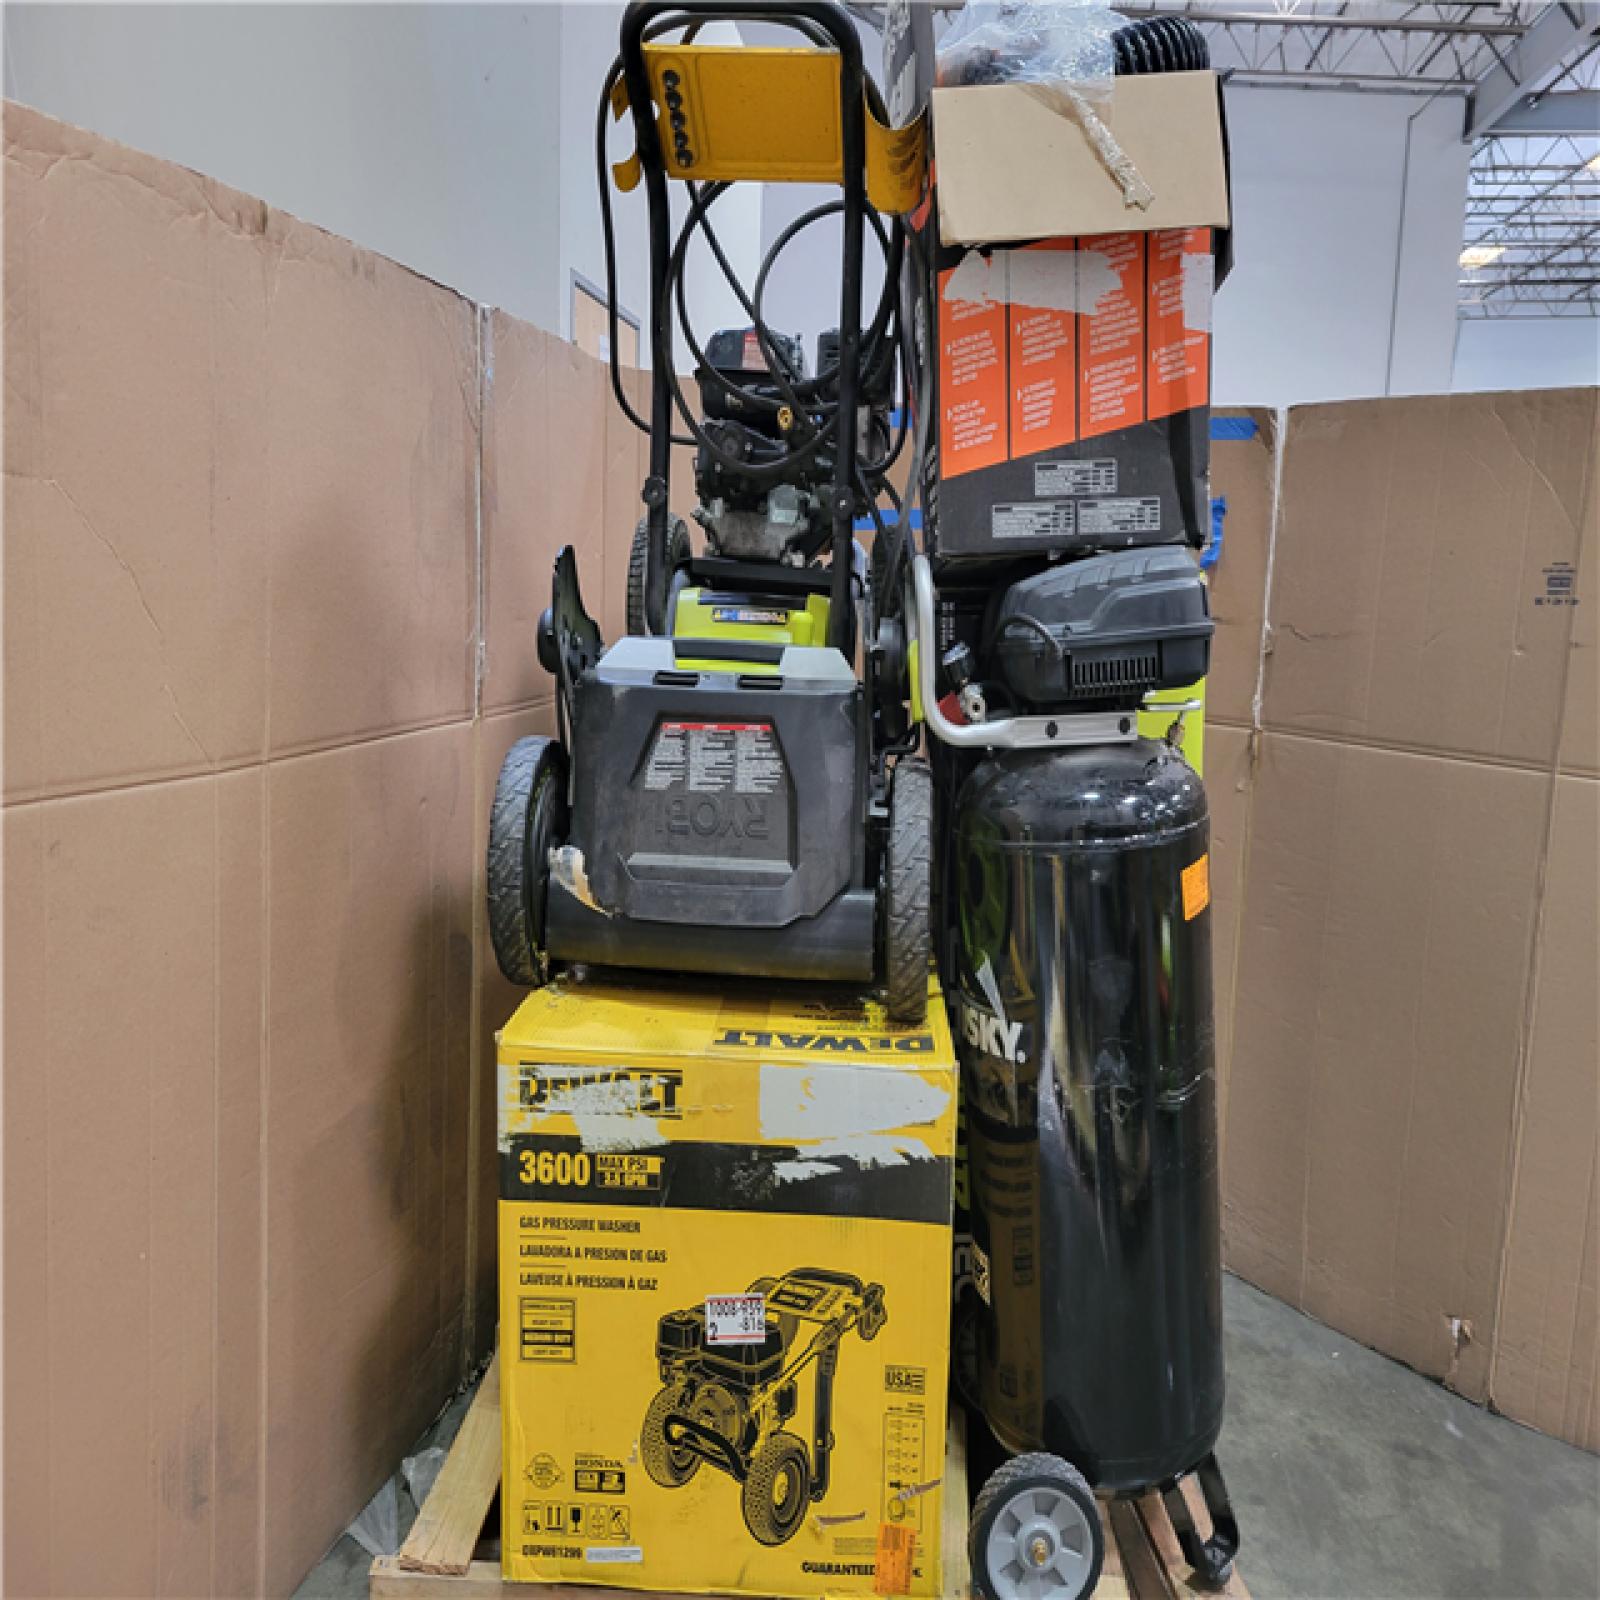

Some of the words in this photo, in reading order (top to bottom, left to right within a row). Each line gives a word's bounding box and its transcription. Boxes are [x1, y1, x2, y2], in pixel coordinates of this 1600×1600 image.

[714, 1029, 935, 1052] DEWALT
[519, 1066, 683, 1115] DLT
[519, 1150, 591, 1186] 3600
[519, 1215, 541, 1229] GAS
[543, 1217, 596, 1231] PRESSURE
[598, 1220, 641, 1233] WASHER
[519, 1245, 573, 1258] LAVADORA
[630, 1250, 643, 1262] DE
[647, 1250, 668, 1263] GAS
[575, 1275, 626, 1288] PRESSION
[638, 1278, 659, 1291] GAZ
[887, 1371, 913, 1388] USA
